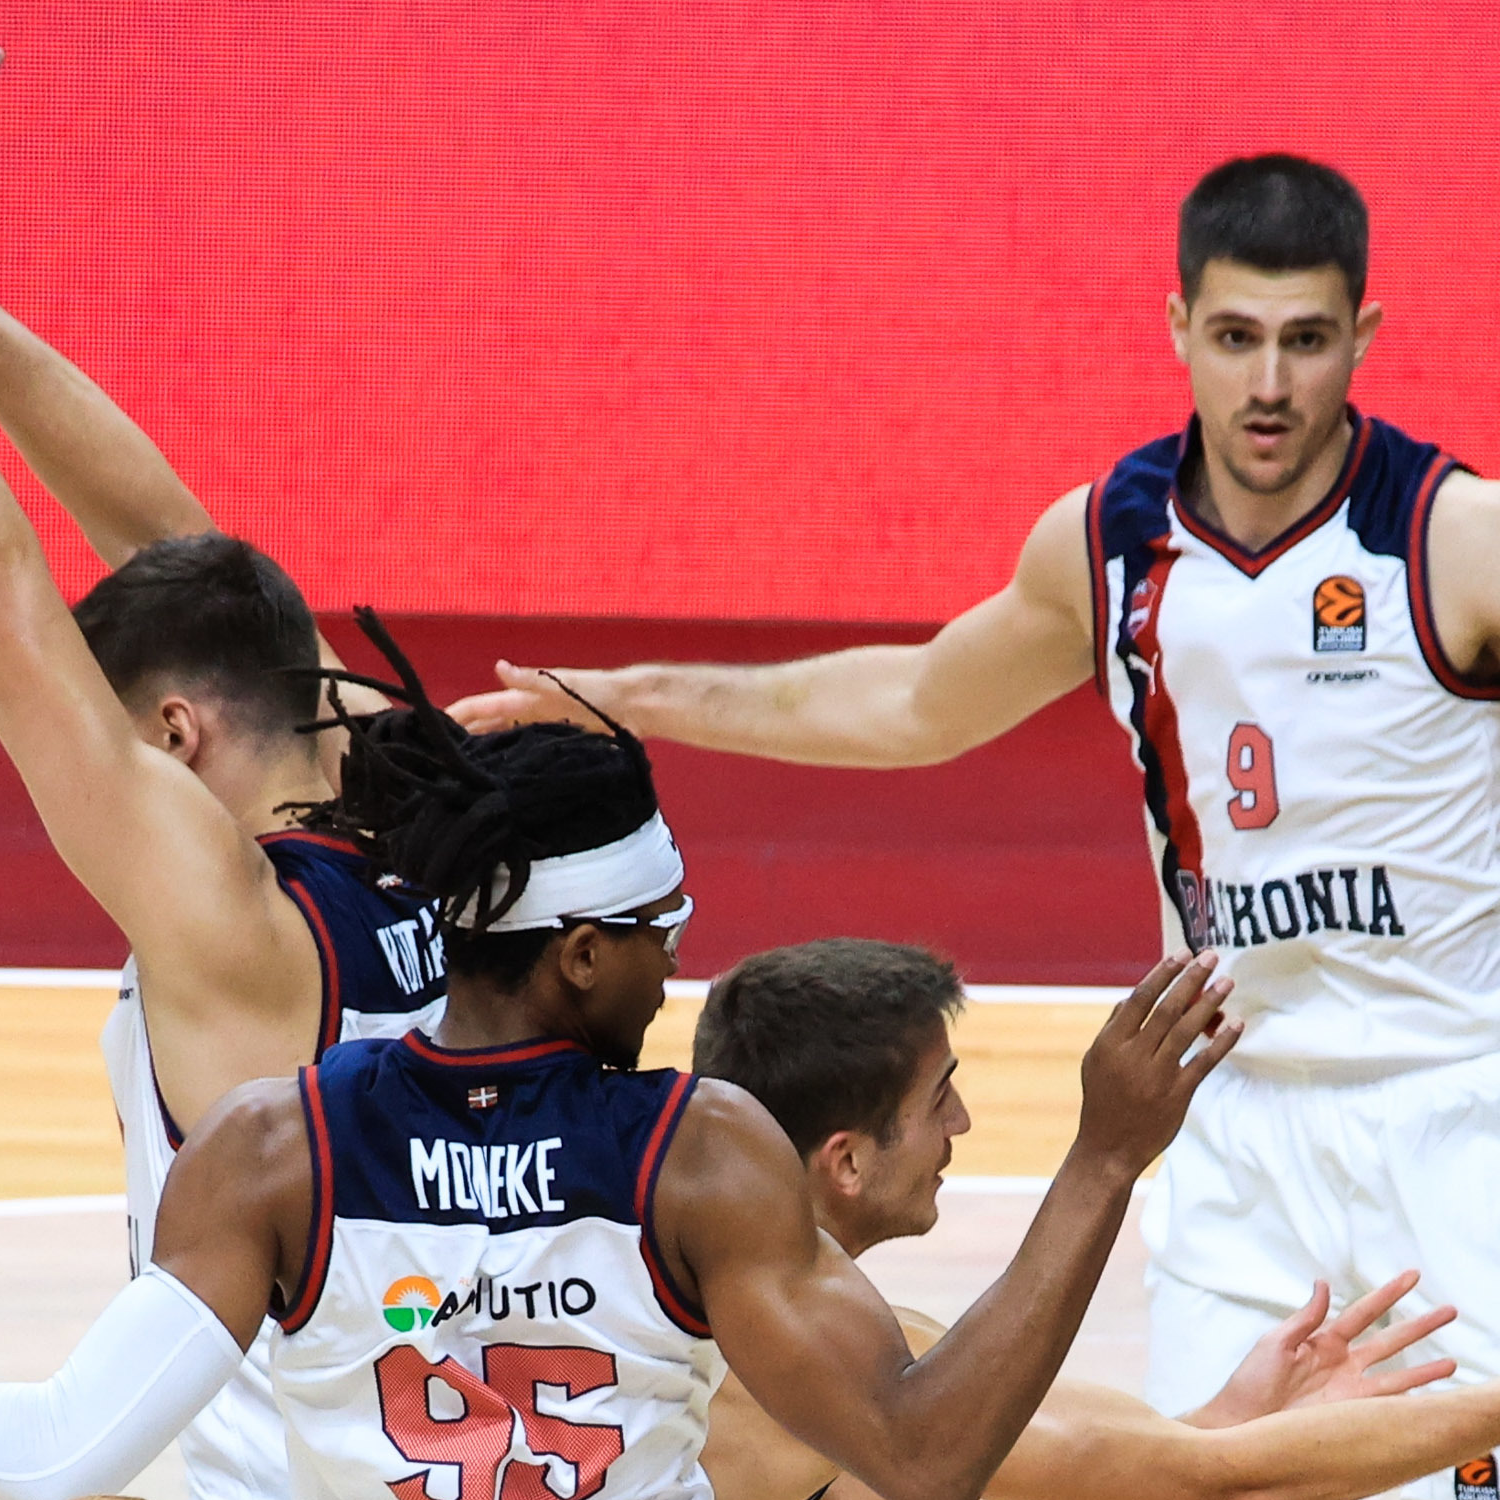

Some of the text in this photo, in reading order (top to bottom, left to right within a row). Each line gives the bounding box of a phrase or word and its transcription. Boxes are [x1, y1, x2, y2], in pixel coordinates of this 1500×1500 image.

[1227, 722, 1280, 830] 9
[1177, 865, 1405, 949] BAKONIA
[409, 1136, 566, 1219] MONEKE
